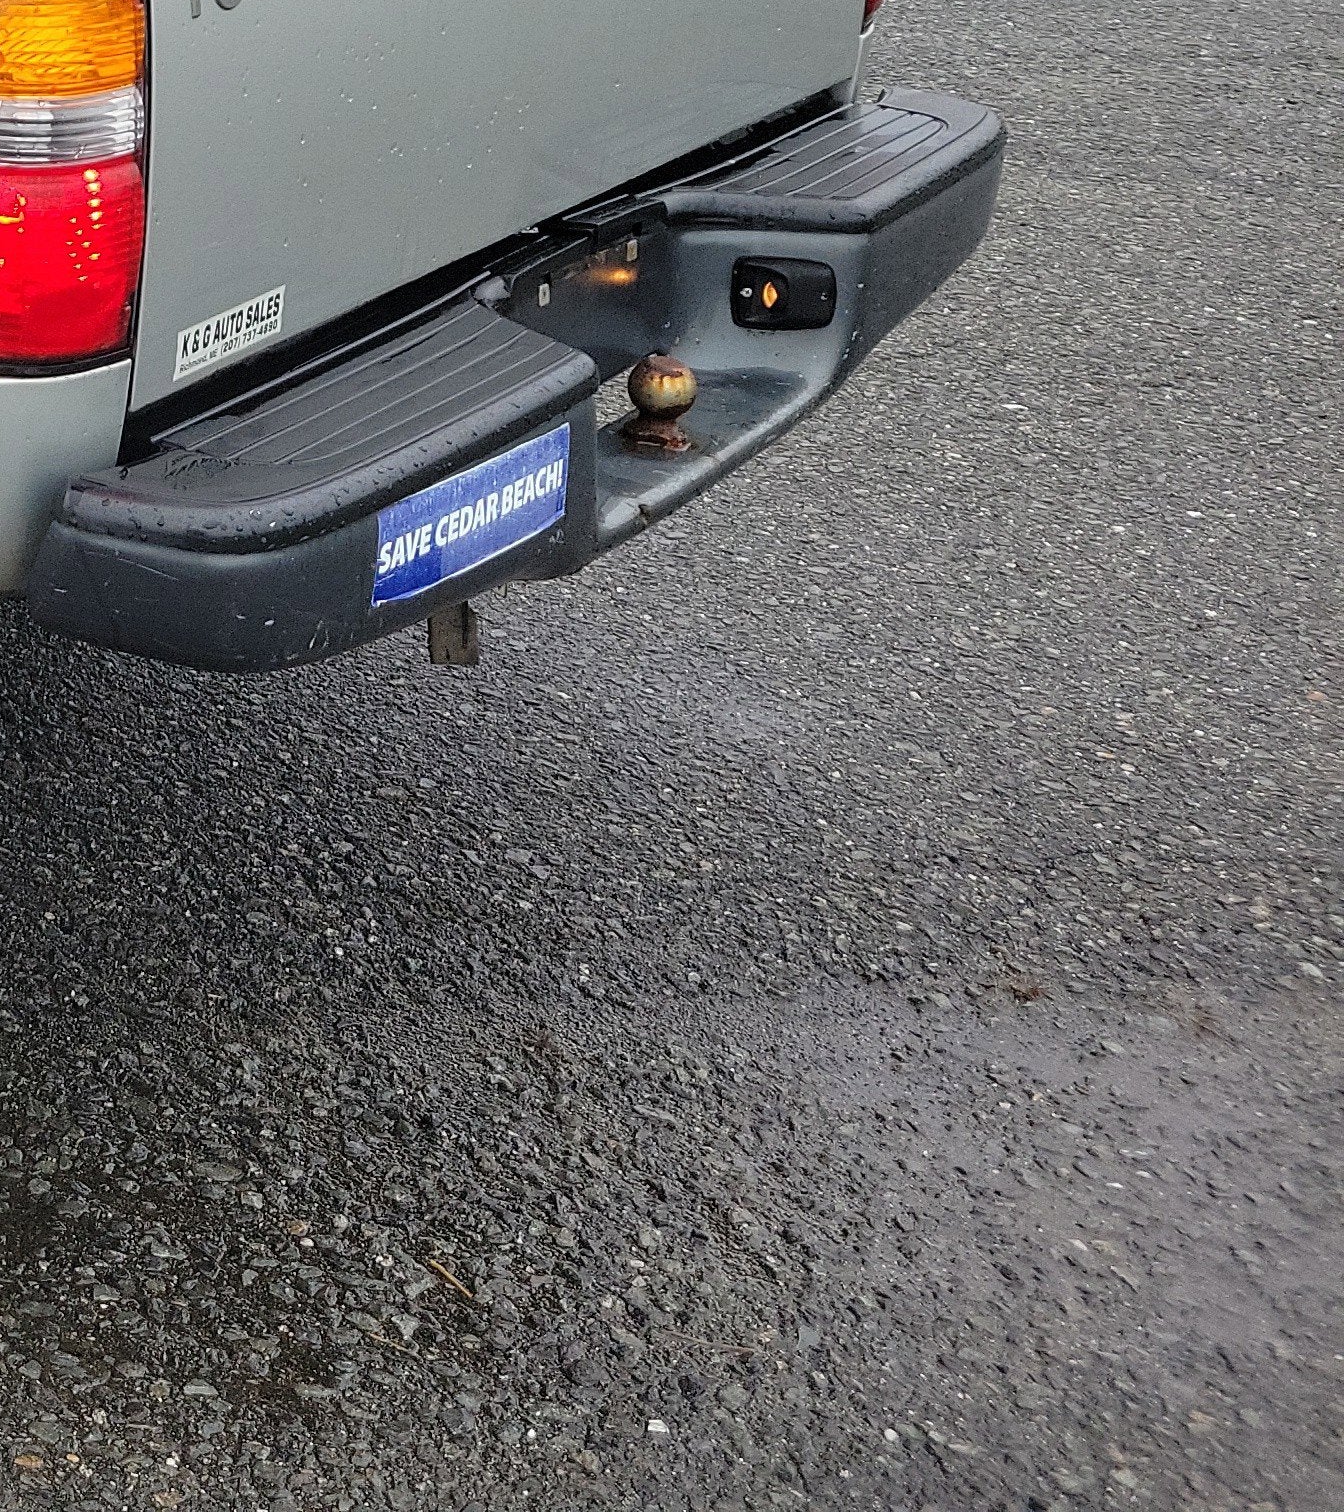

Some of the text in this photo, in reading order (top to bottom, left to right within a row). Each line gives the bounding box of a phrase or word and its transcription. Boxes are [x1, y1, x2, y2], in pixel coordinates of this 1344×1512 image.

[182, 293, 280, 358] K & G AUTO SALES
[220, 337, 240, 356] (207)
[378, 458, 564, 574] SAVE CEDAR BEACH!
